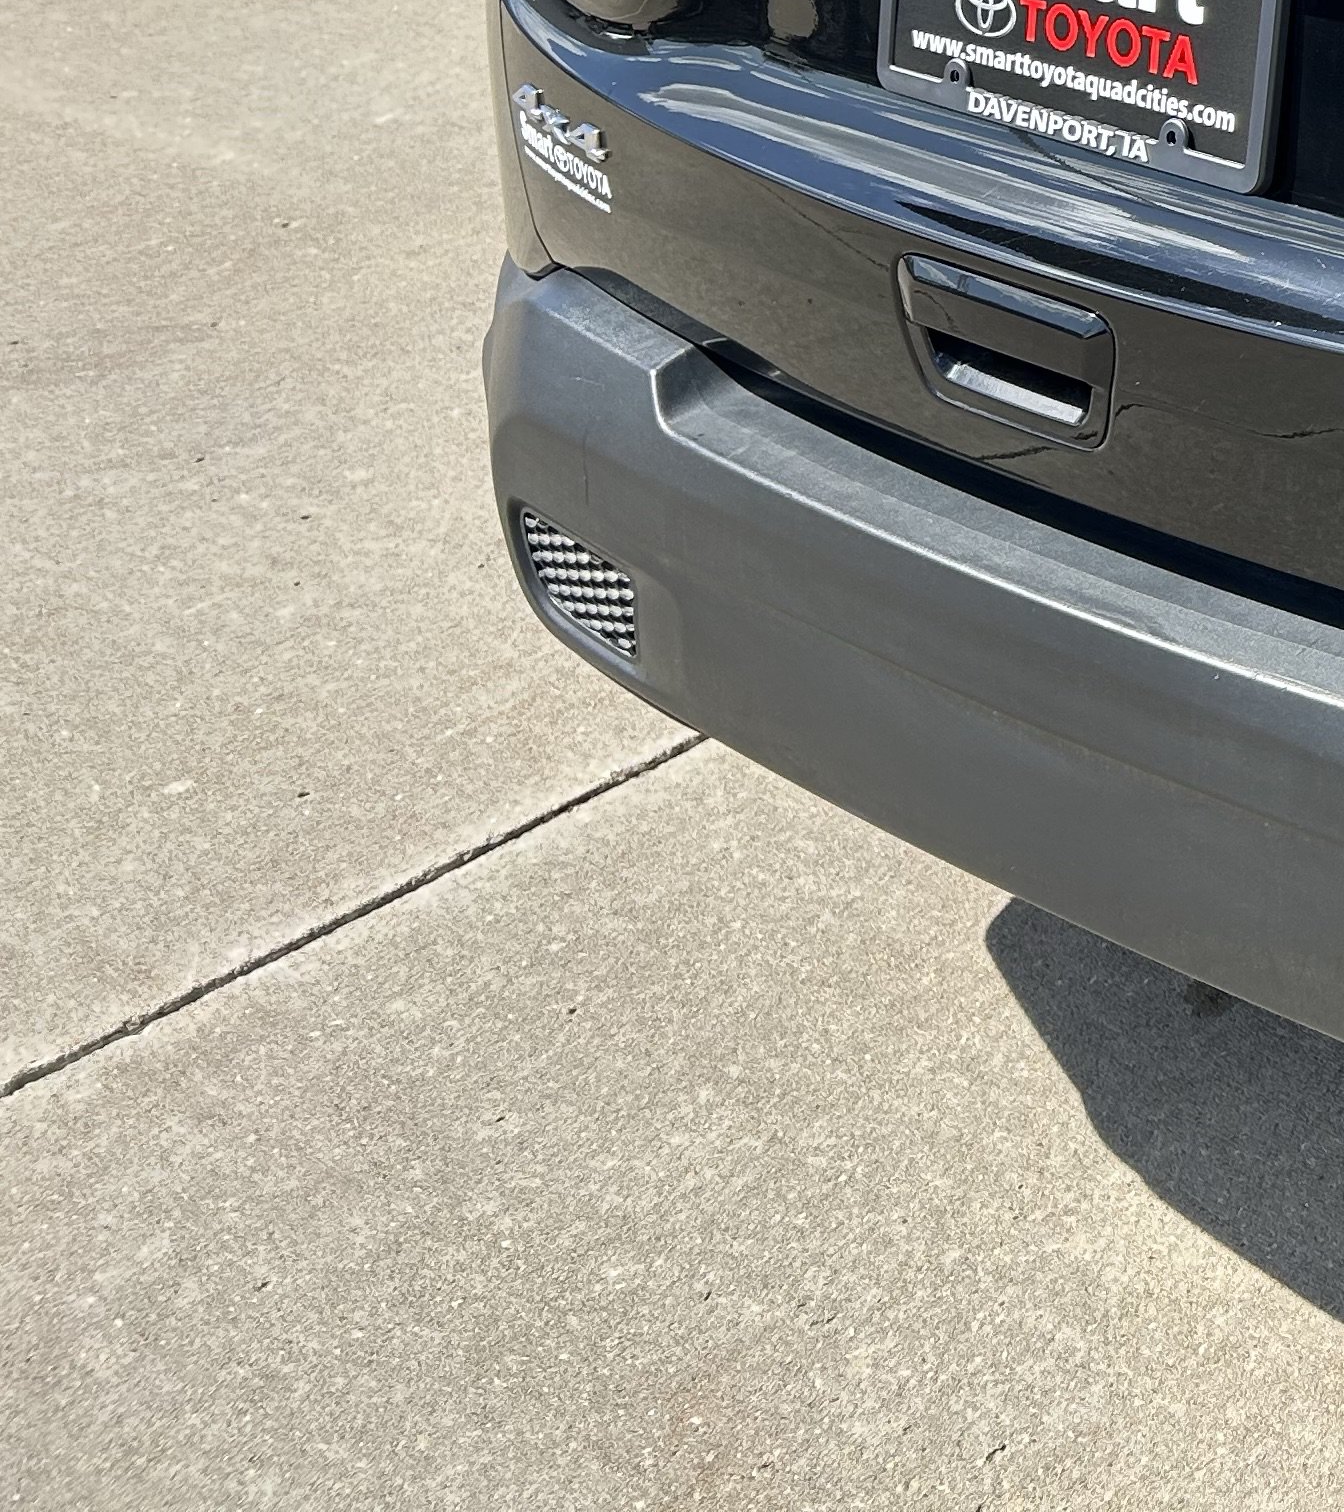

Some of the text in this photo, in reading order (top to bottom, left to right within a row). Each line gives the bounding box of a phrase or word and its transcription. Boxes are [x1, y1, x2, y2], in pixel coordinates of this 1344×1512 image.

[911, 28, 1236, 132] www.smarttoyotaquadcities.com
[966, 92, 1150, 163] DAVENPORT, IA
[566, 153, 612, 199] TOYOTA
